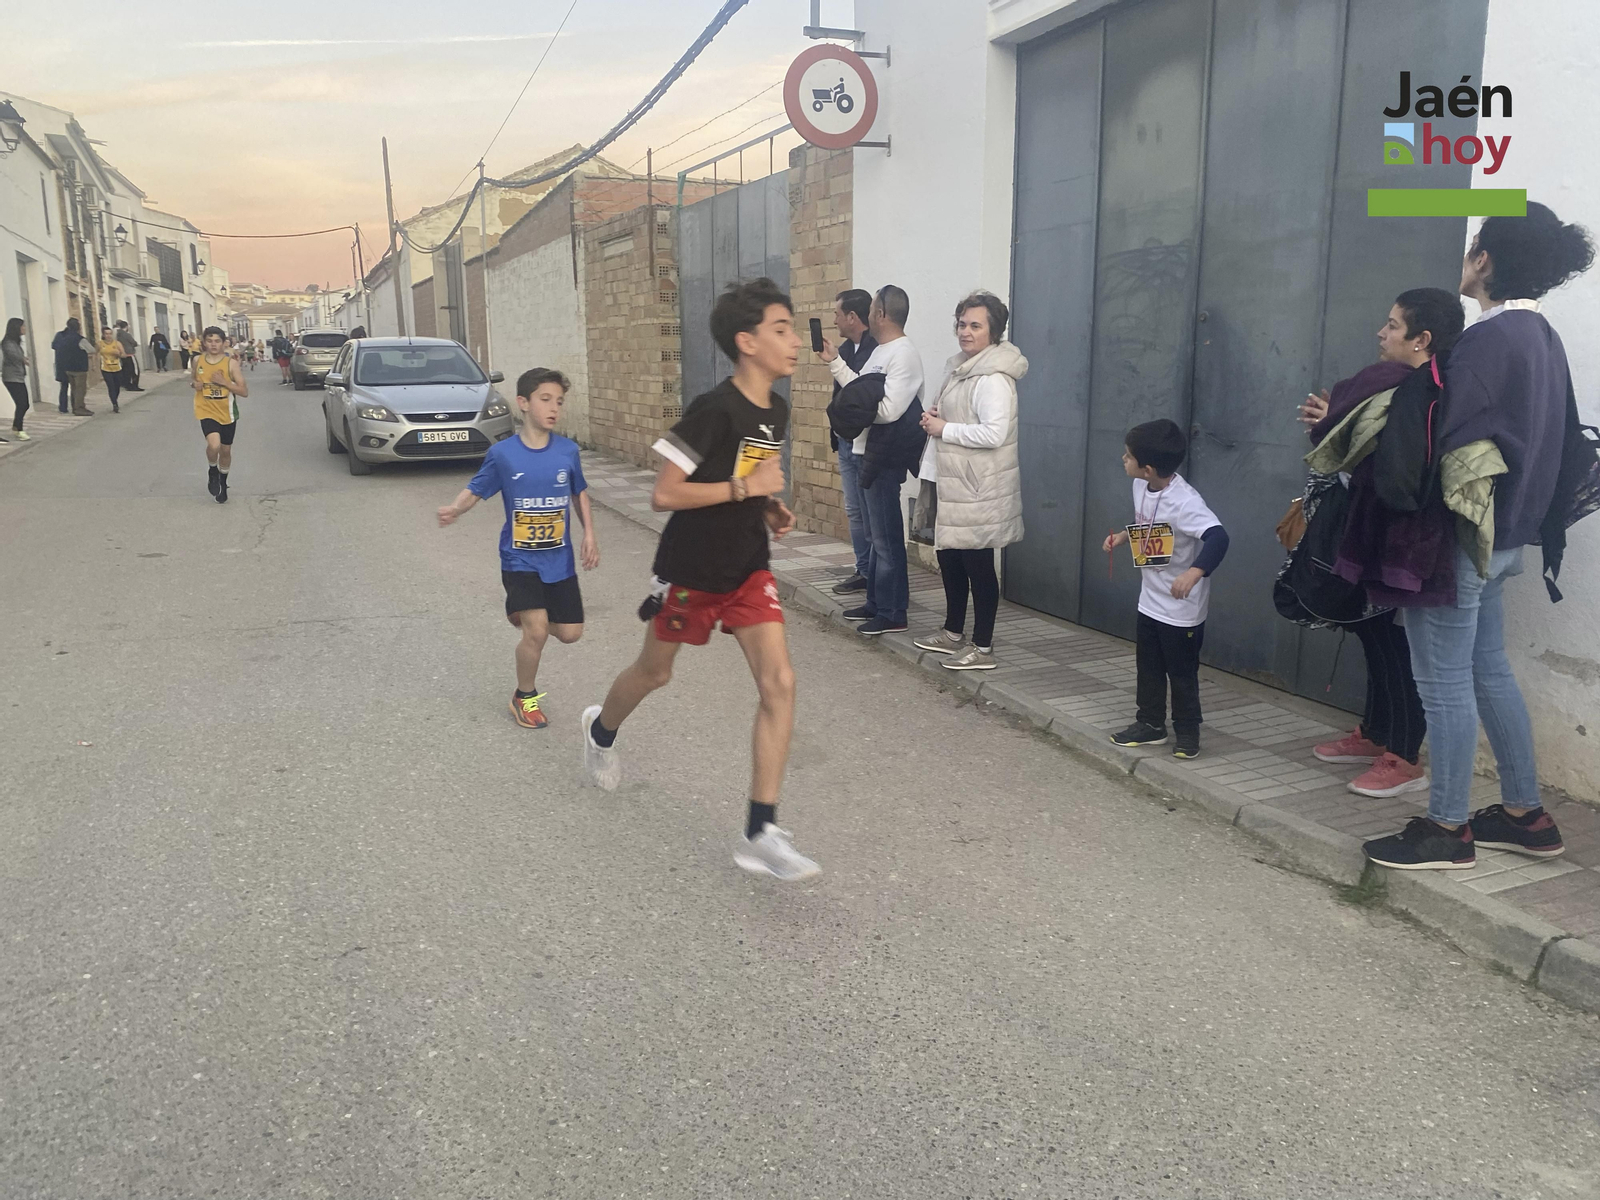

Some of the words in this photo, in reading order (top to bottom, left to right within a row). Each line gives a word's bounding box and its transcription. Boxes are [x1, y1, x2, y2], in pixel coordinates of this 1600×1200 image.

[210, 389, 222, 397] 361
[423, 432, 447, 442] 5815
[450, 431, 467, 440] GVG
[526, 524, 555, 541] 332
